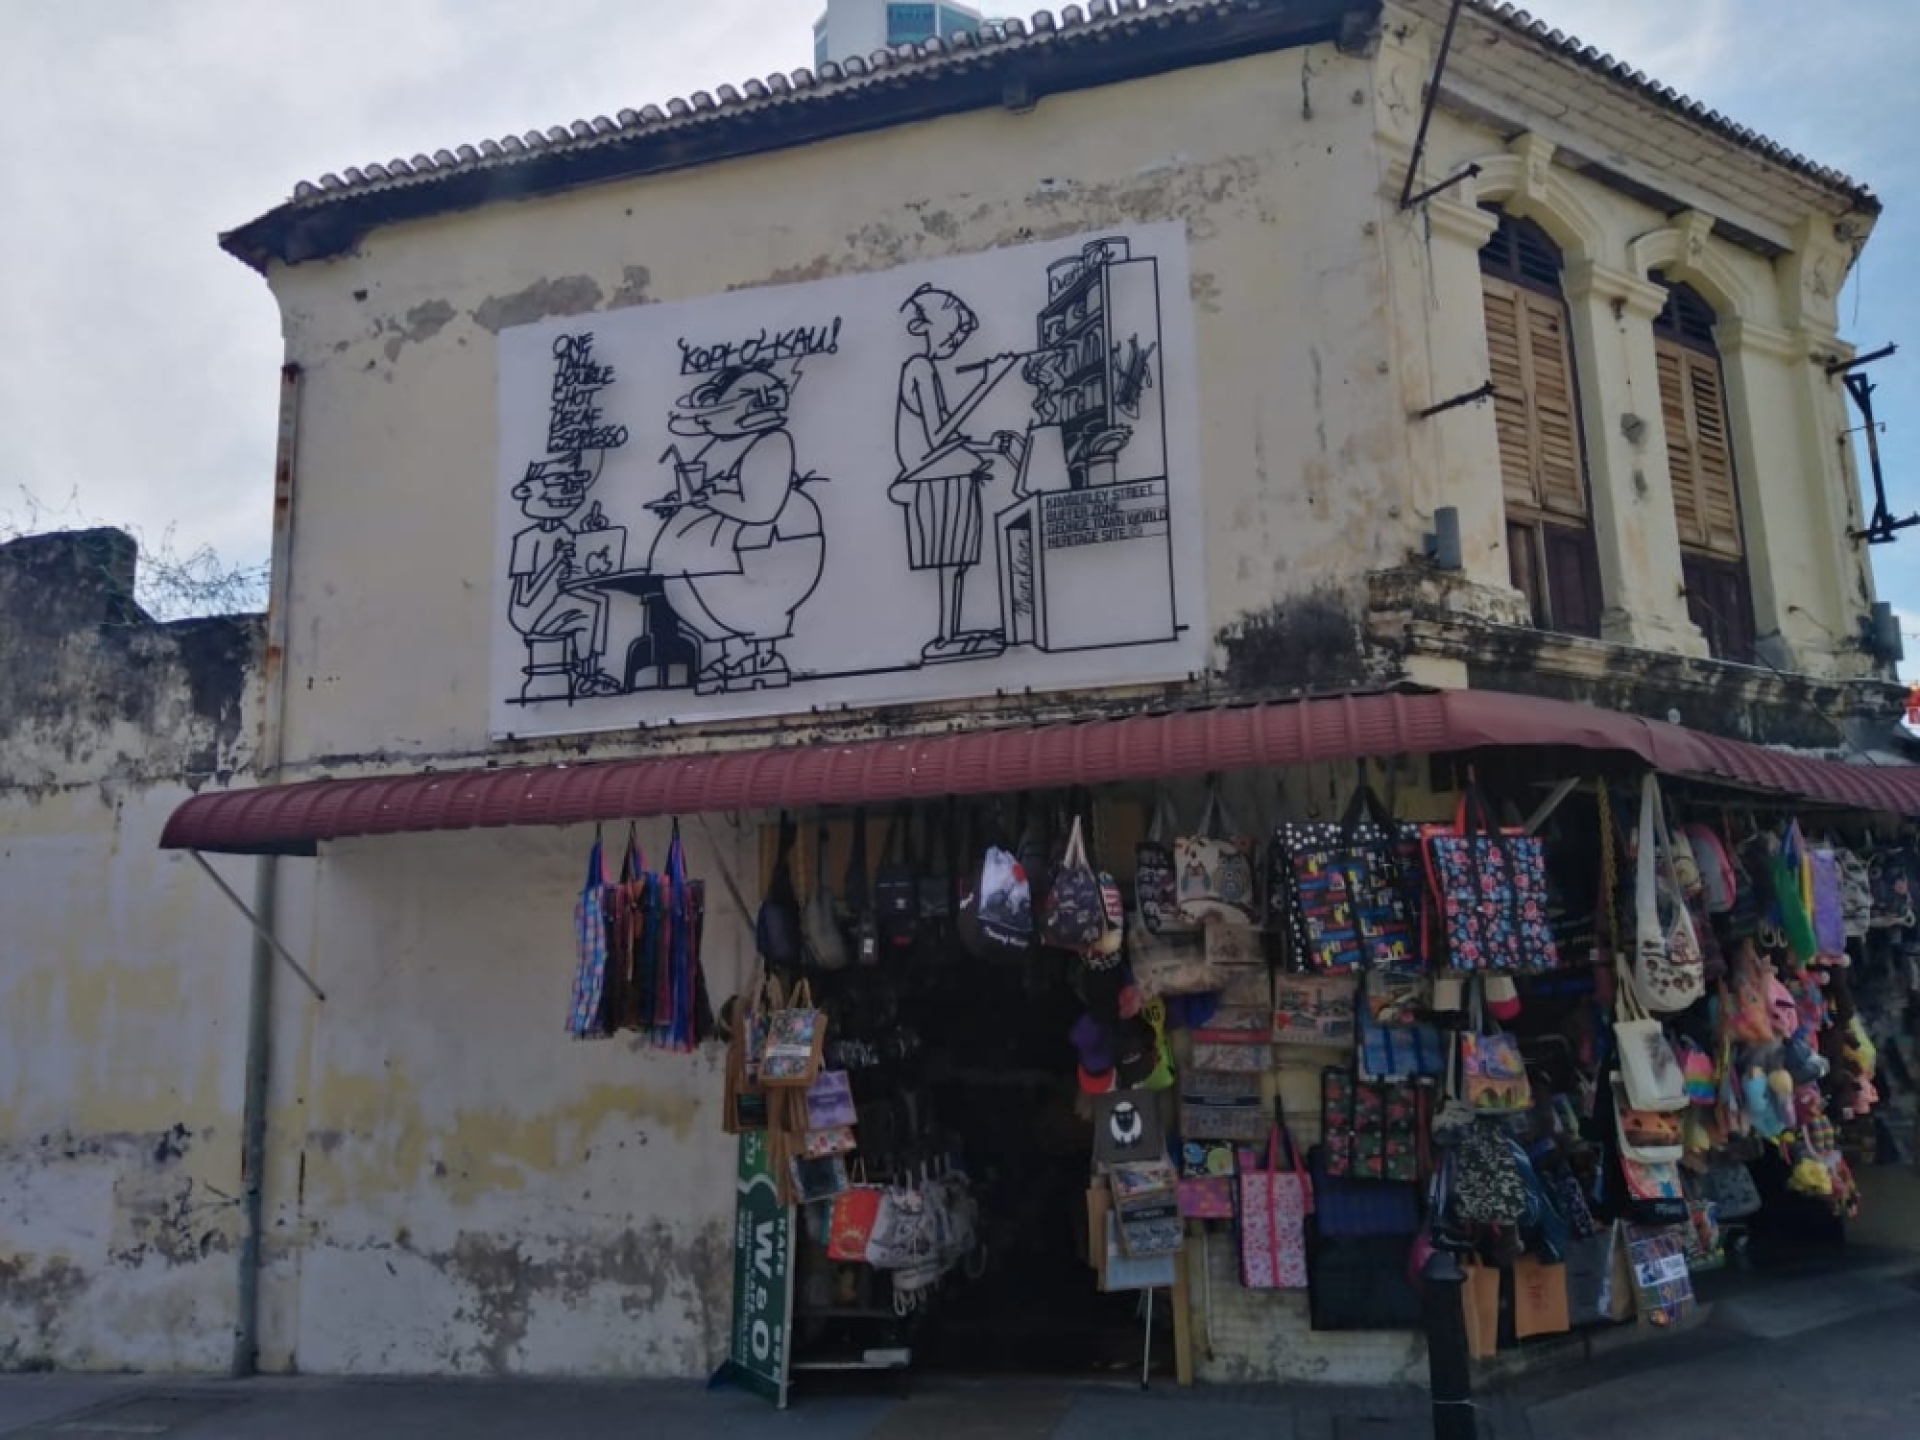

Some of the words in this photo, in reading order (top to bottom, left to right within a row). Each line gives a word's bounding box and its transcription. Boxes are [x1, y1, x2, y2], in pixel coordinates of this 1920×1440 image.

[553, 332, 594, 360] ONE
[547, 424, 629, 453] ESPRESSO
[1046, 490, 1109, 510] KIMBERLEY
[1112, 484, 1153, 501] STREET
[1094, 513, 1125, 529] TOWN
[1127, 506, 1168, 525] WORLD
[1047, 530, 1099, 549] HERITAGE
[1102, 527, 1126, 542] SITE
[755, 1220, 774, 1280] W
[752, 1318, 769, 1361] O
